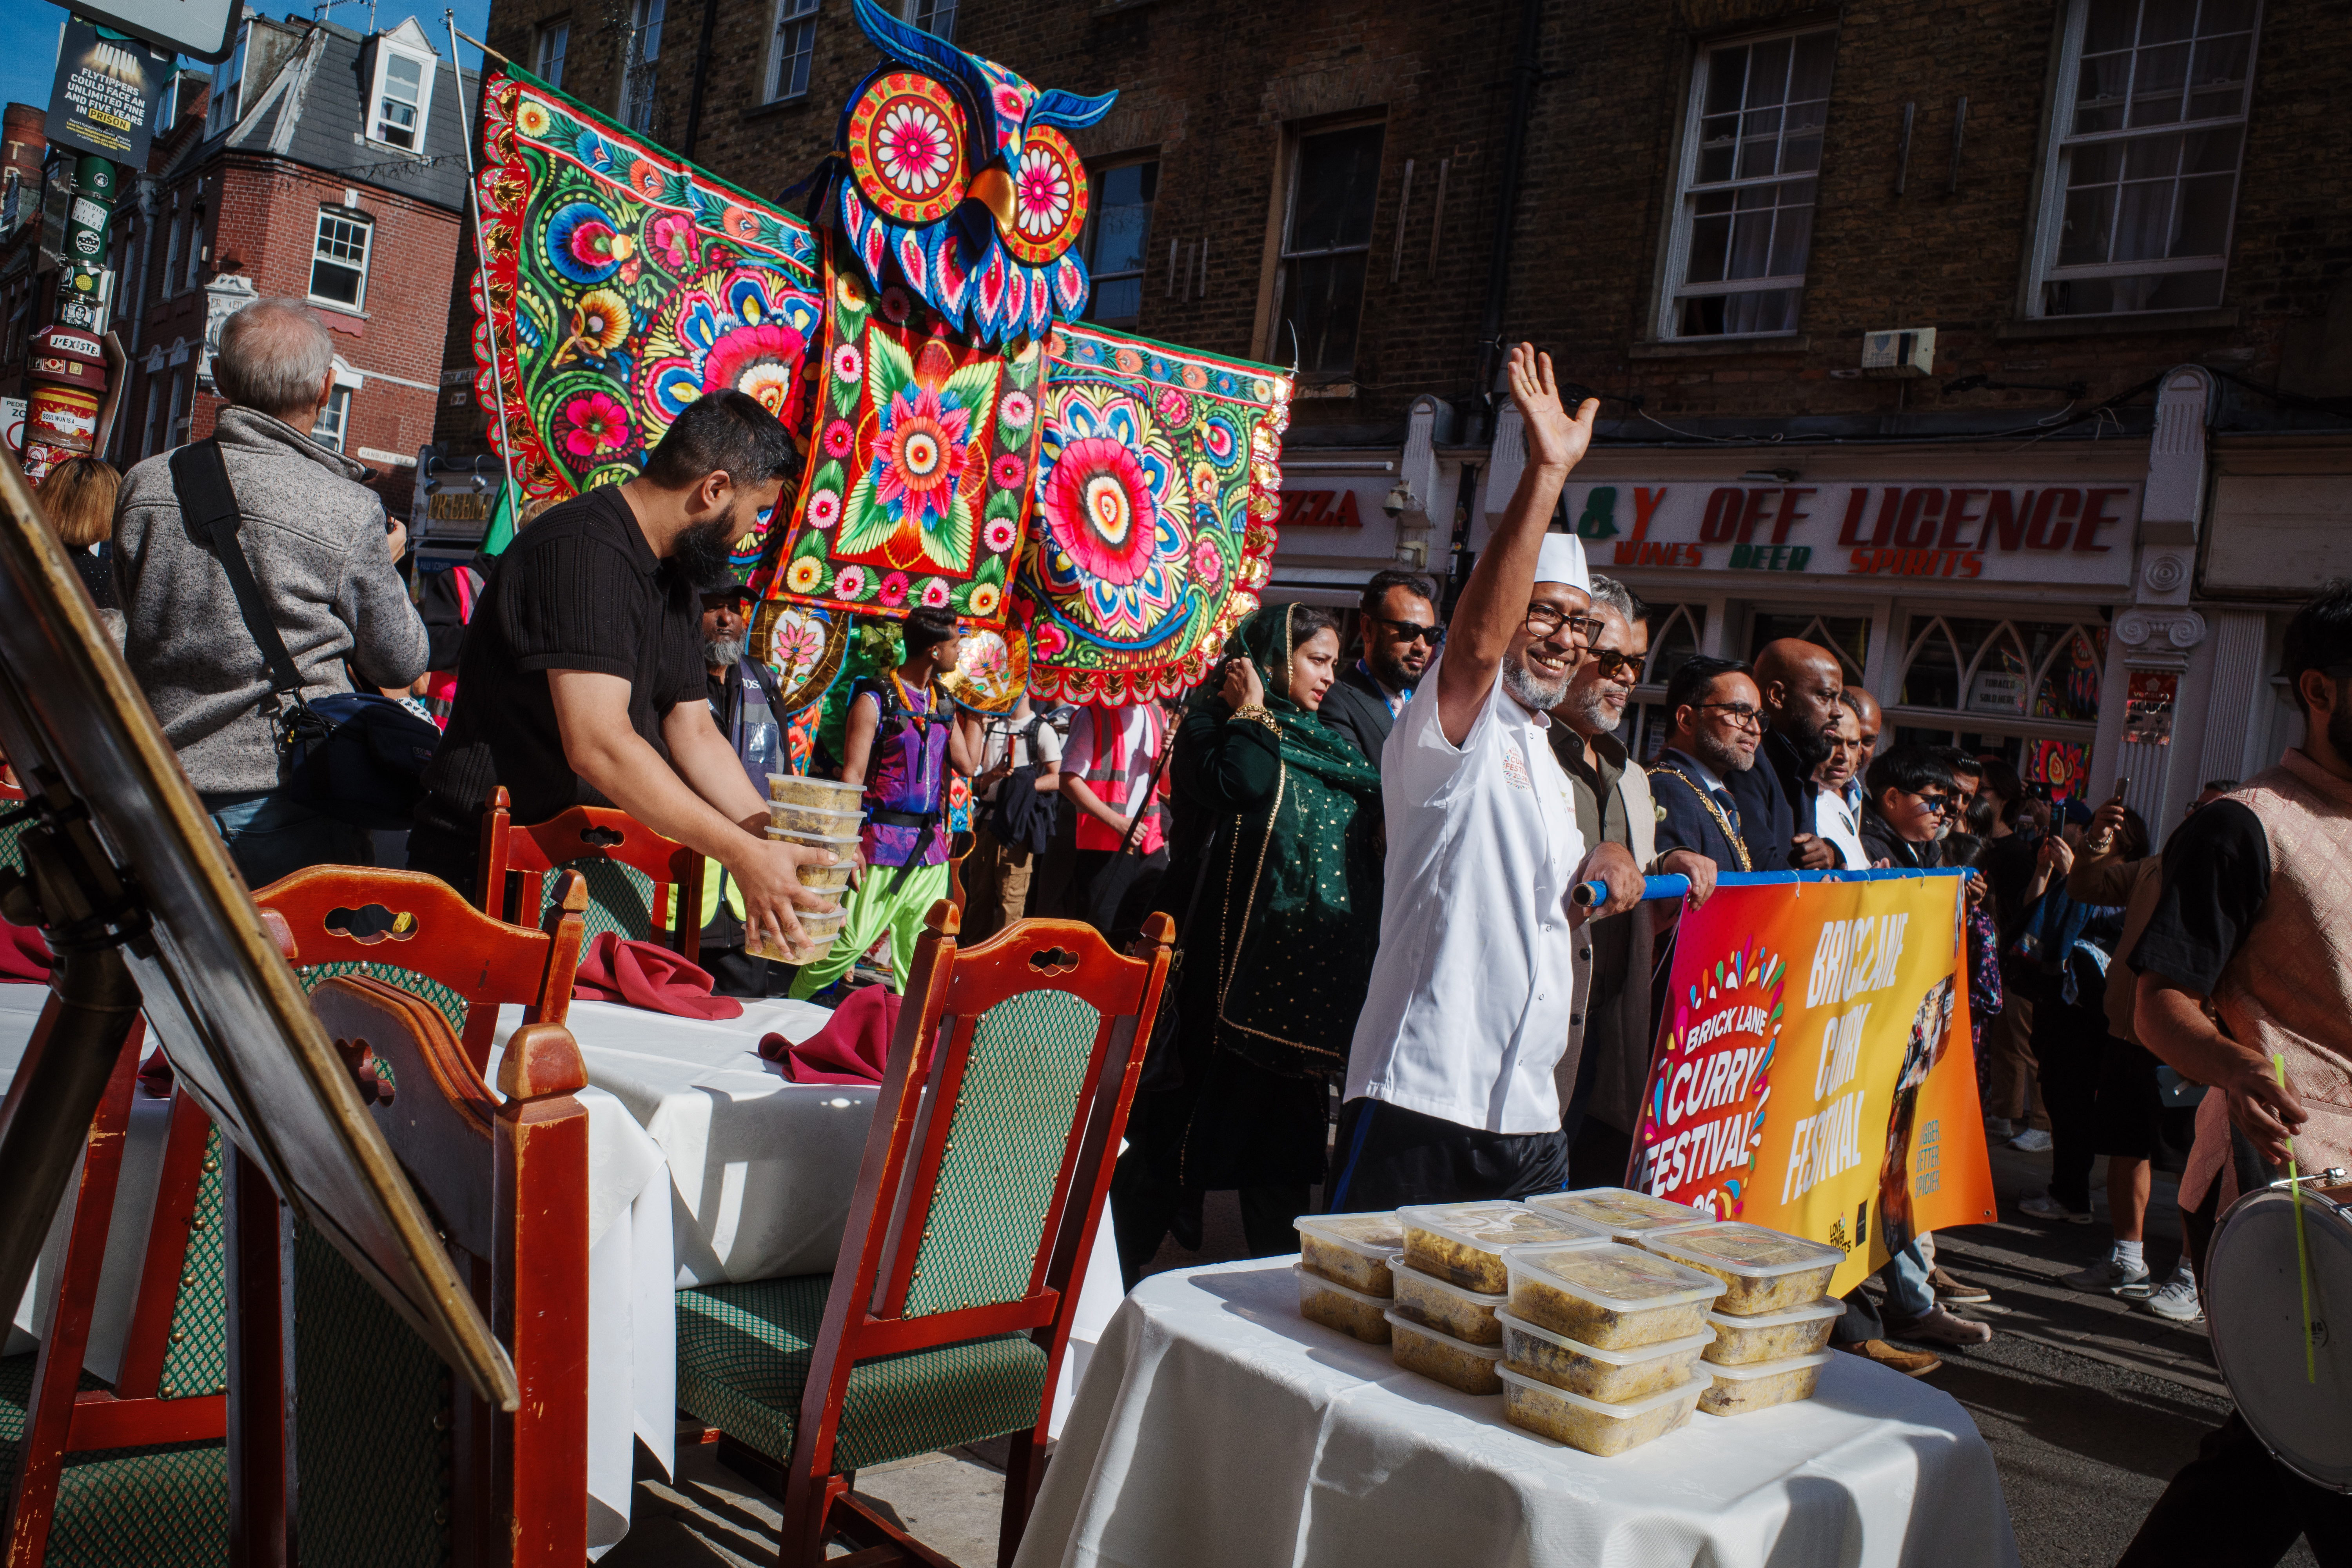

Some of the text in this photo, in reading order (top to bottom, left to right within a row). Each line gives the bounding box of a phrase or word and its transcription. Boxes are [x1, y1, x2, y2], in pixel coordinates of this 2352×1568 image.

[71, 74, 145, 108] COULD FACE AN
[82, 68, 139, 96] FLYTIPPERS
[65, 91, 143, 126] AND FIVE YEARS
[67, 82, 145, 117] UNLIMITED FINE
[76, 105, 129, 130] IN PRISON.
[82, 122, 98, 131] flytipping
[73, 213, 101, 229] TATTOO
[78, 200, 106, 216] CHILDISH
[53, 338, 98, 354] J'EXISTE.
[361, 450, 392, 461] HANBURY
[427, 493, 493, 520] PREEM
[1275, 490, 1362, 527] ZZA
[1577, 487, 1619, 539] &
[1631, 487, 1667, 541] Y
[1700, 487, 1817, 544] OFF
[1837, 487, 2130, 552] LICENCE
[1614, 541, 1985, 578] WINES BEER SPIRITS
[1985, 679, 2015, 689] TOBACCO
[1980, 693, 2015, 704] SOLD HERE
[2130, 701, 2171, 713] ALARM
[1685, 1005, 1768, 1056] BRICK LANE
[1666, 1047, 1766, 1126] CURRY
[1918, 1119, 1941, 1147] IGGER.
[1637, 1111, 1752, 1198] FESTIVAL
[1916, 1145, 1940, 1173] BETTER.
[1915, 1169, 1940, 1199] SPICIER.
[1830, 1217, 1842, 1238] LOVE
